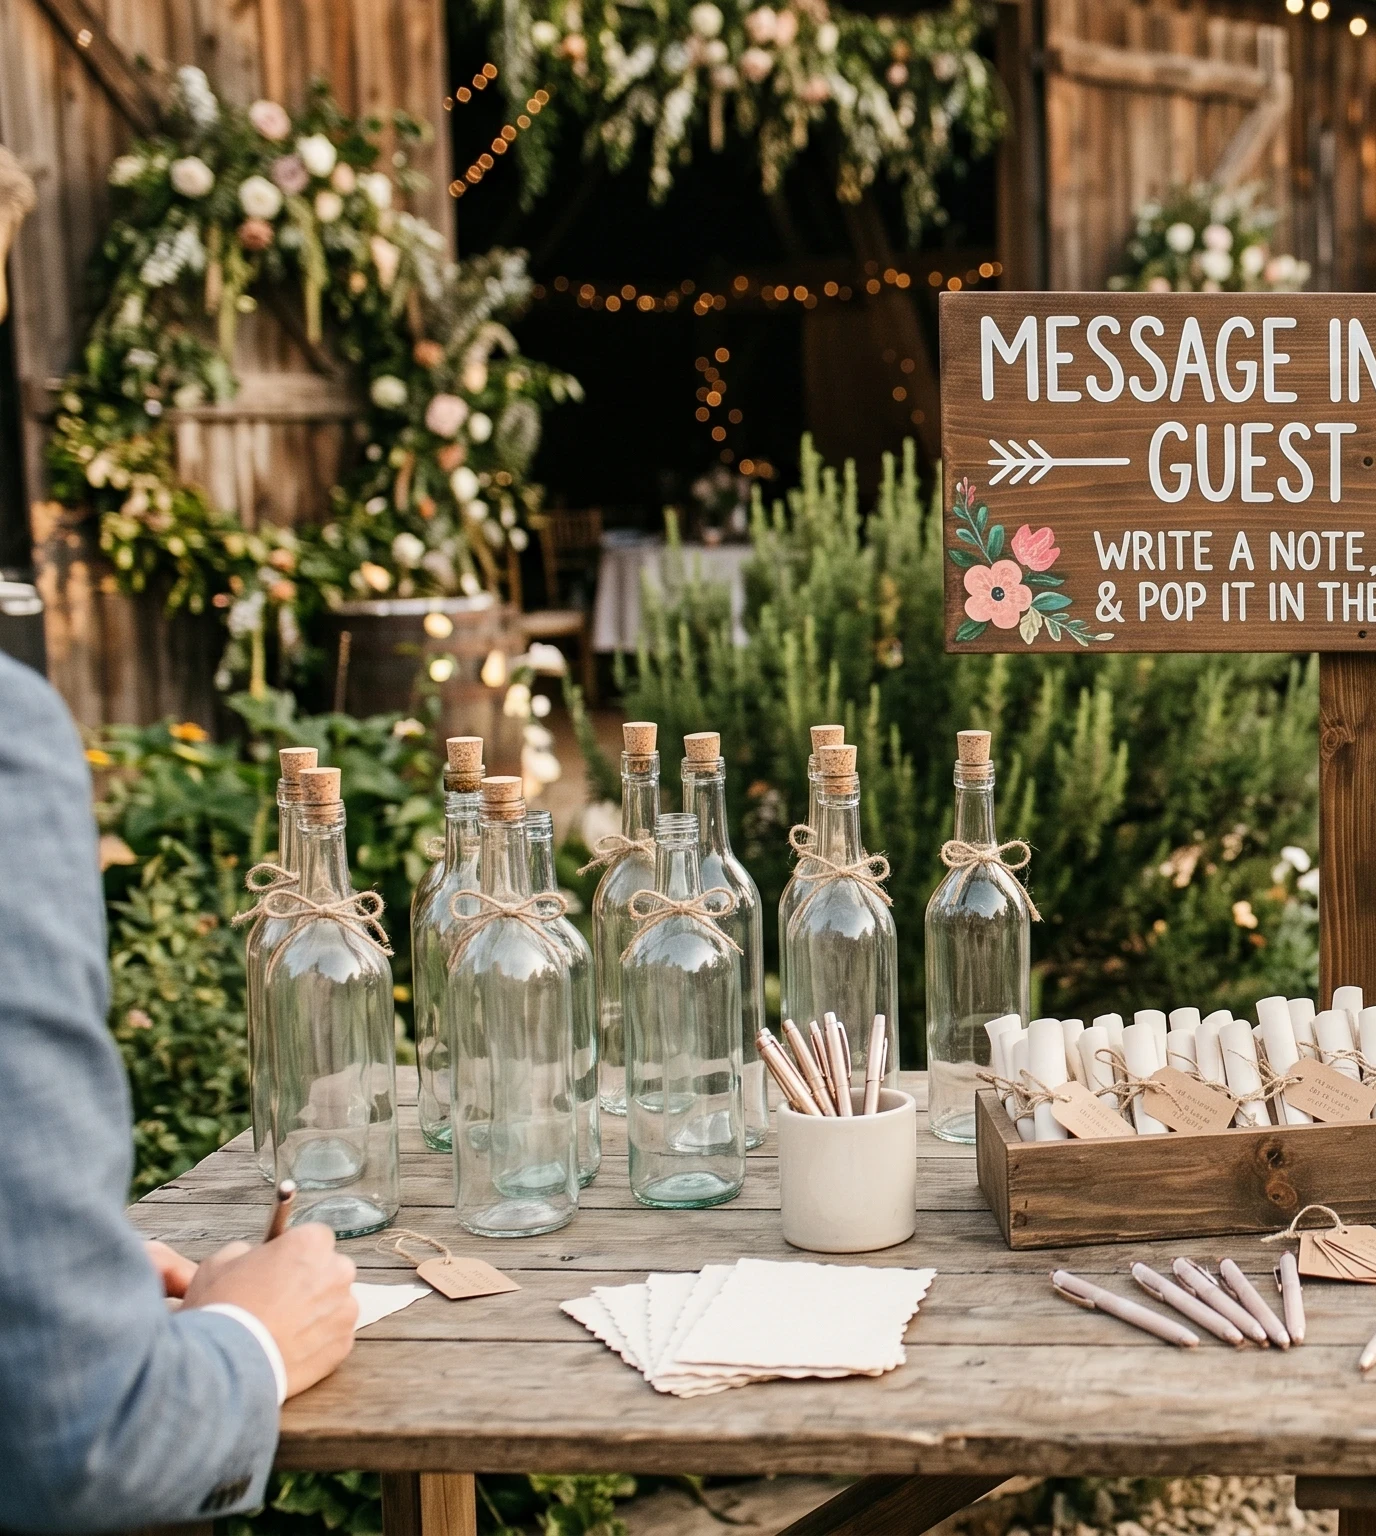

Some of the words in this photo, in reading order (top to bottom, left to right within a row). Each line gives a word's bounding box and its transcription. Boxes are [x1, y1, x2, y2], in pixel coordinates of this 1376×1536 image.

[980, 315, 1298, 403] MESSAGE
[1148, 420, 1358, 504] GUEST
[1093, 530, 1214, 572] WRITE
[1228, 530, 1255, 572] A
[1095, 580, 1126, 623] &
[1138, 581, 1207, 622] POP
[1221, 581, 1256, 622] IT
[1268, 581, 1305, 622] IN
